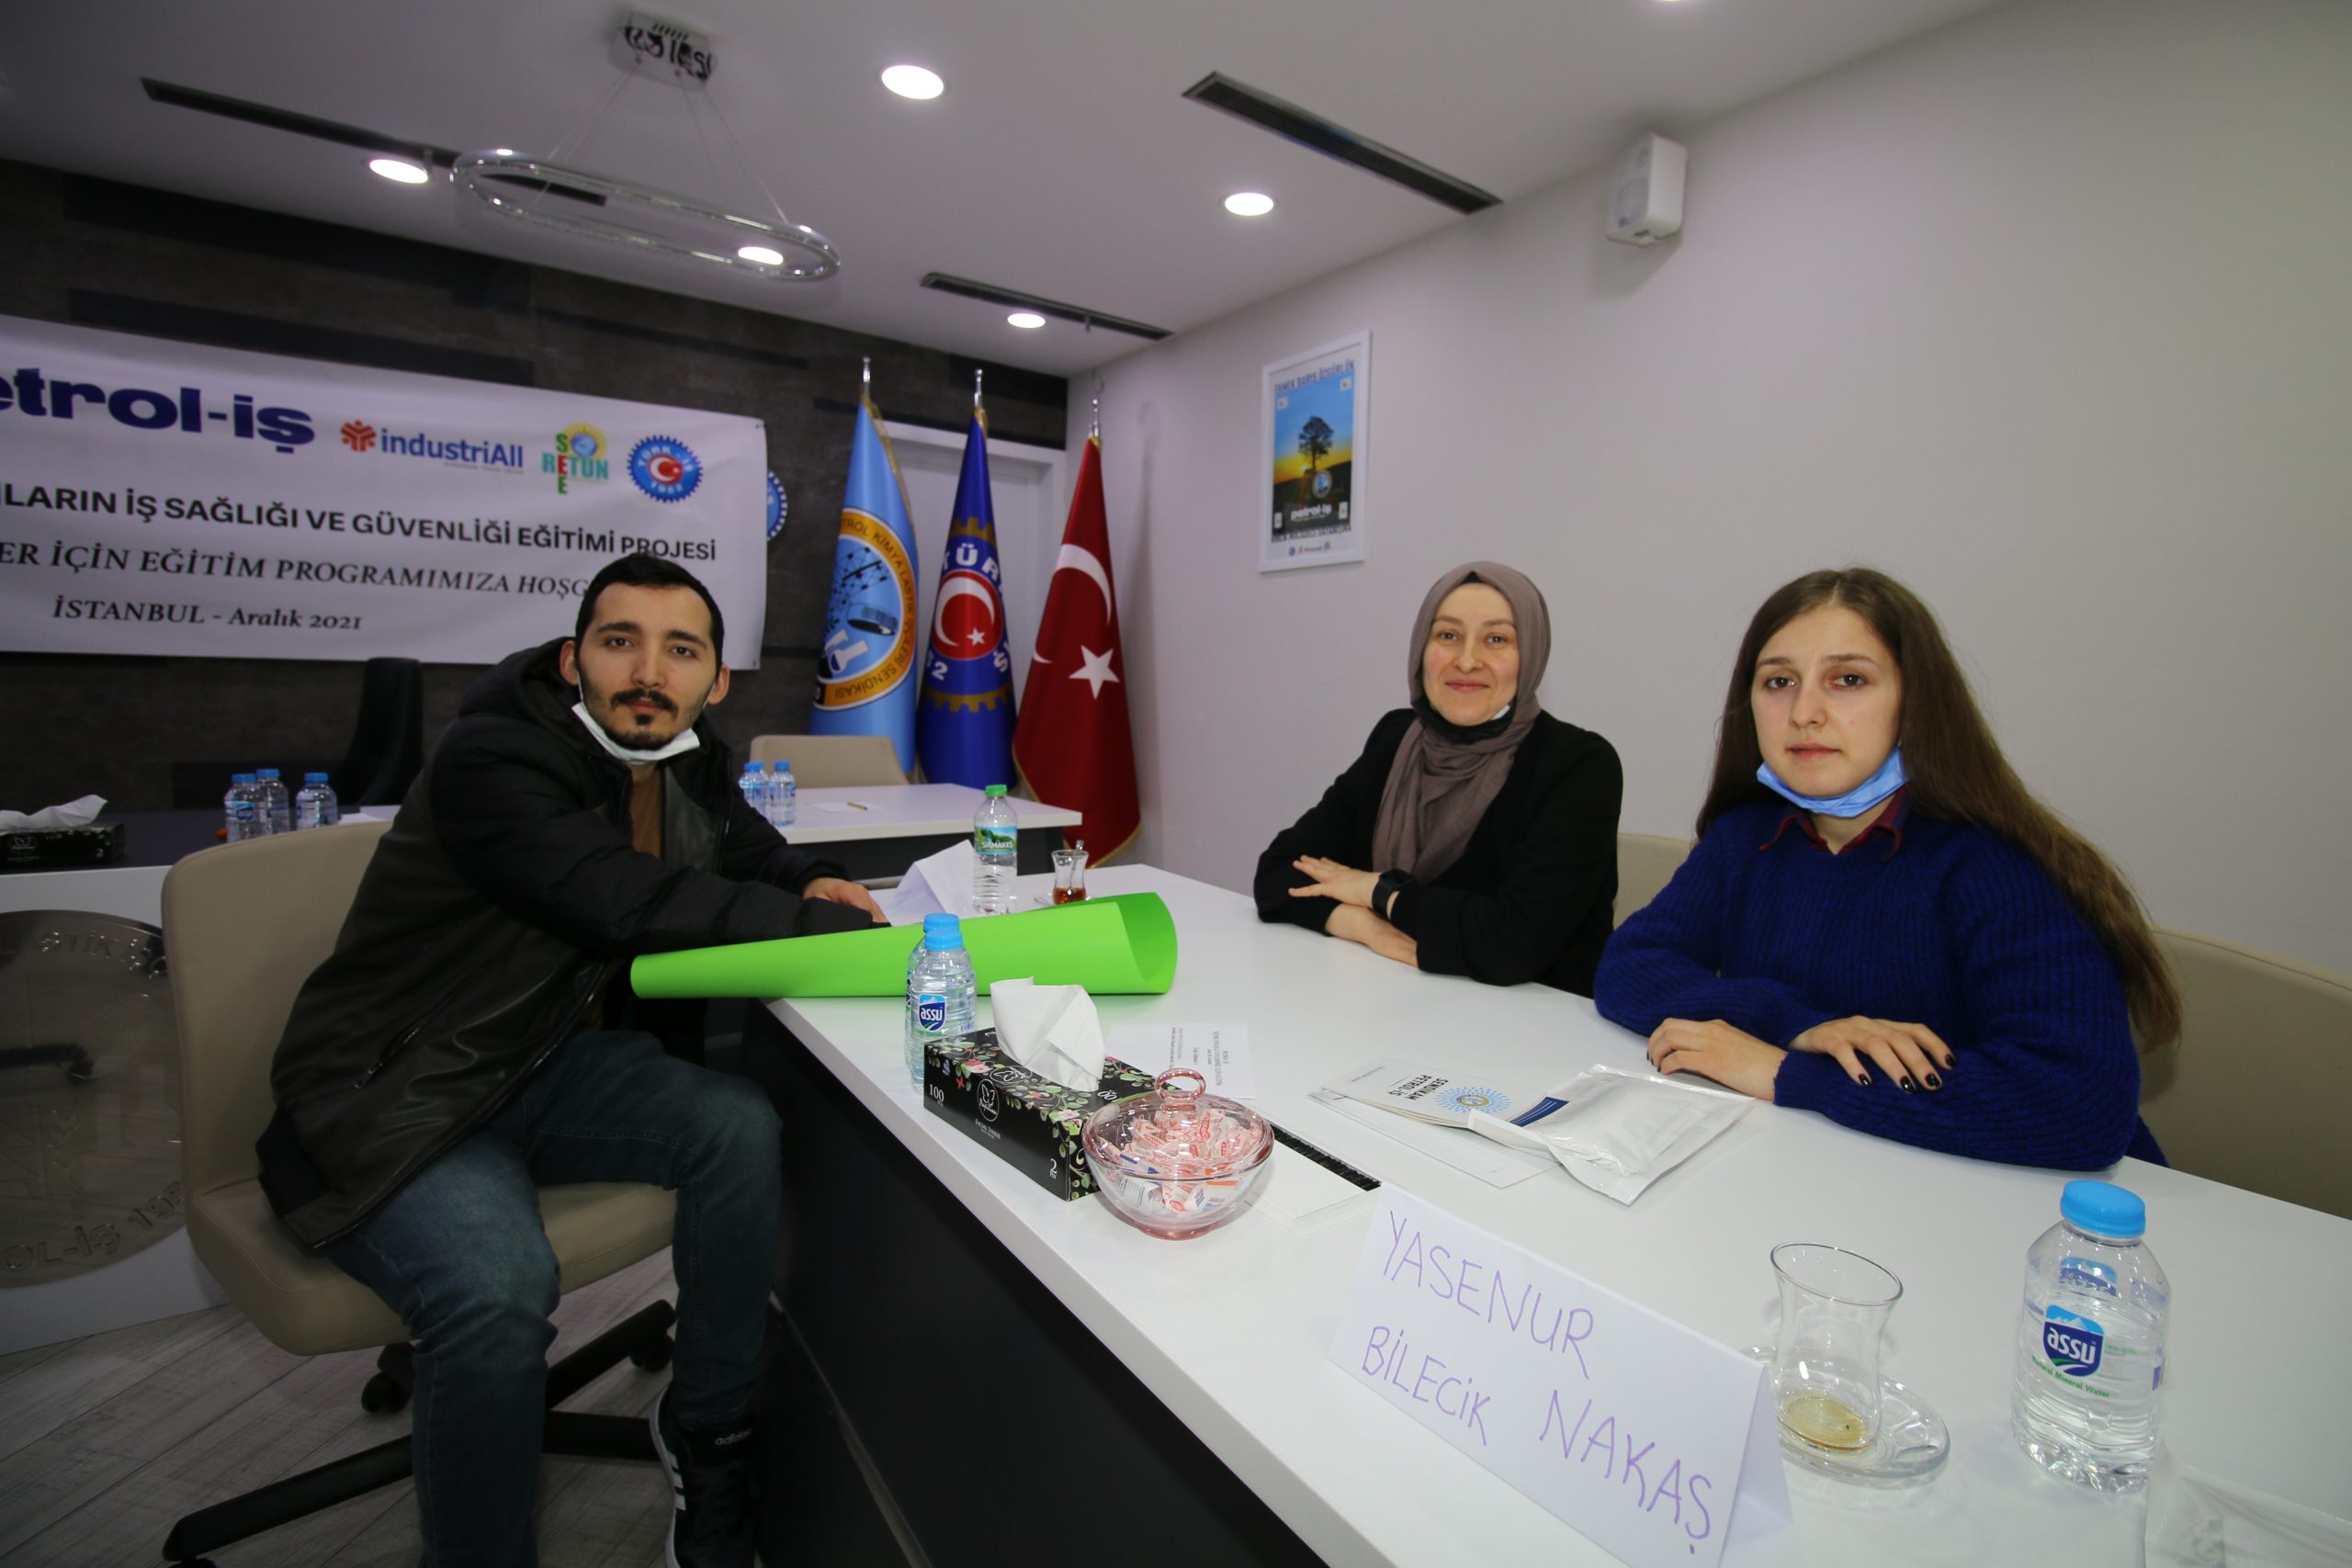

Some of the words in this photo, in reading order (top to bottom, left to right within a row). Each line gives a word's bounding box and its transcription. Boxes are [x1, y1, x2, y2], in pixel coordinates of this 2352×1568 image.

[0, 368, 315, 454] trol-iş
[381, 429, 523, 469] industriAll
[0, 483, 116, 513] LARIN
[126, 489, 157, 523] İŞ
[164, 497, 298, 528] SAĞLIĞI
[305, 510, 345, 533] VE
[353, 511, 510, 545] GÜVENLİĞİ
[518, 524, 614, 554] EĞİTİMİ
[621, 536, 716, 560] PROJESİ
[50, 540, 130, 574] İÇİN
[140, 547, 266, 579] EĞİTİM
[276, 561, 509, 593] PROGRAMIMIZA
[52, 595, 205, 625] İSTANBUL
[228, 607, 302, 629] Aralık
[309, 615, 361, 631] 2021
[921, 1007, 944, 1021] assu
[929, 1084, 944, 1102] 100
[1383, 1210, 1594, 1380] YASENUR
[2047, 1326, 2097, 1365] assu
[2031, 1354, 2053, 1375] Natural
[2054, 1371, 2084, 1390] Mineral
[2085, 1383, 2110, 1398] Water
[1538, 1389, 1713, 1554] NAKAŞ
